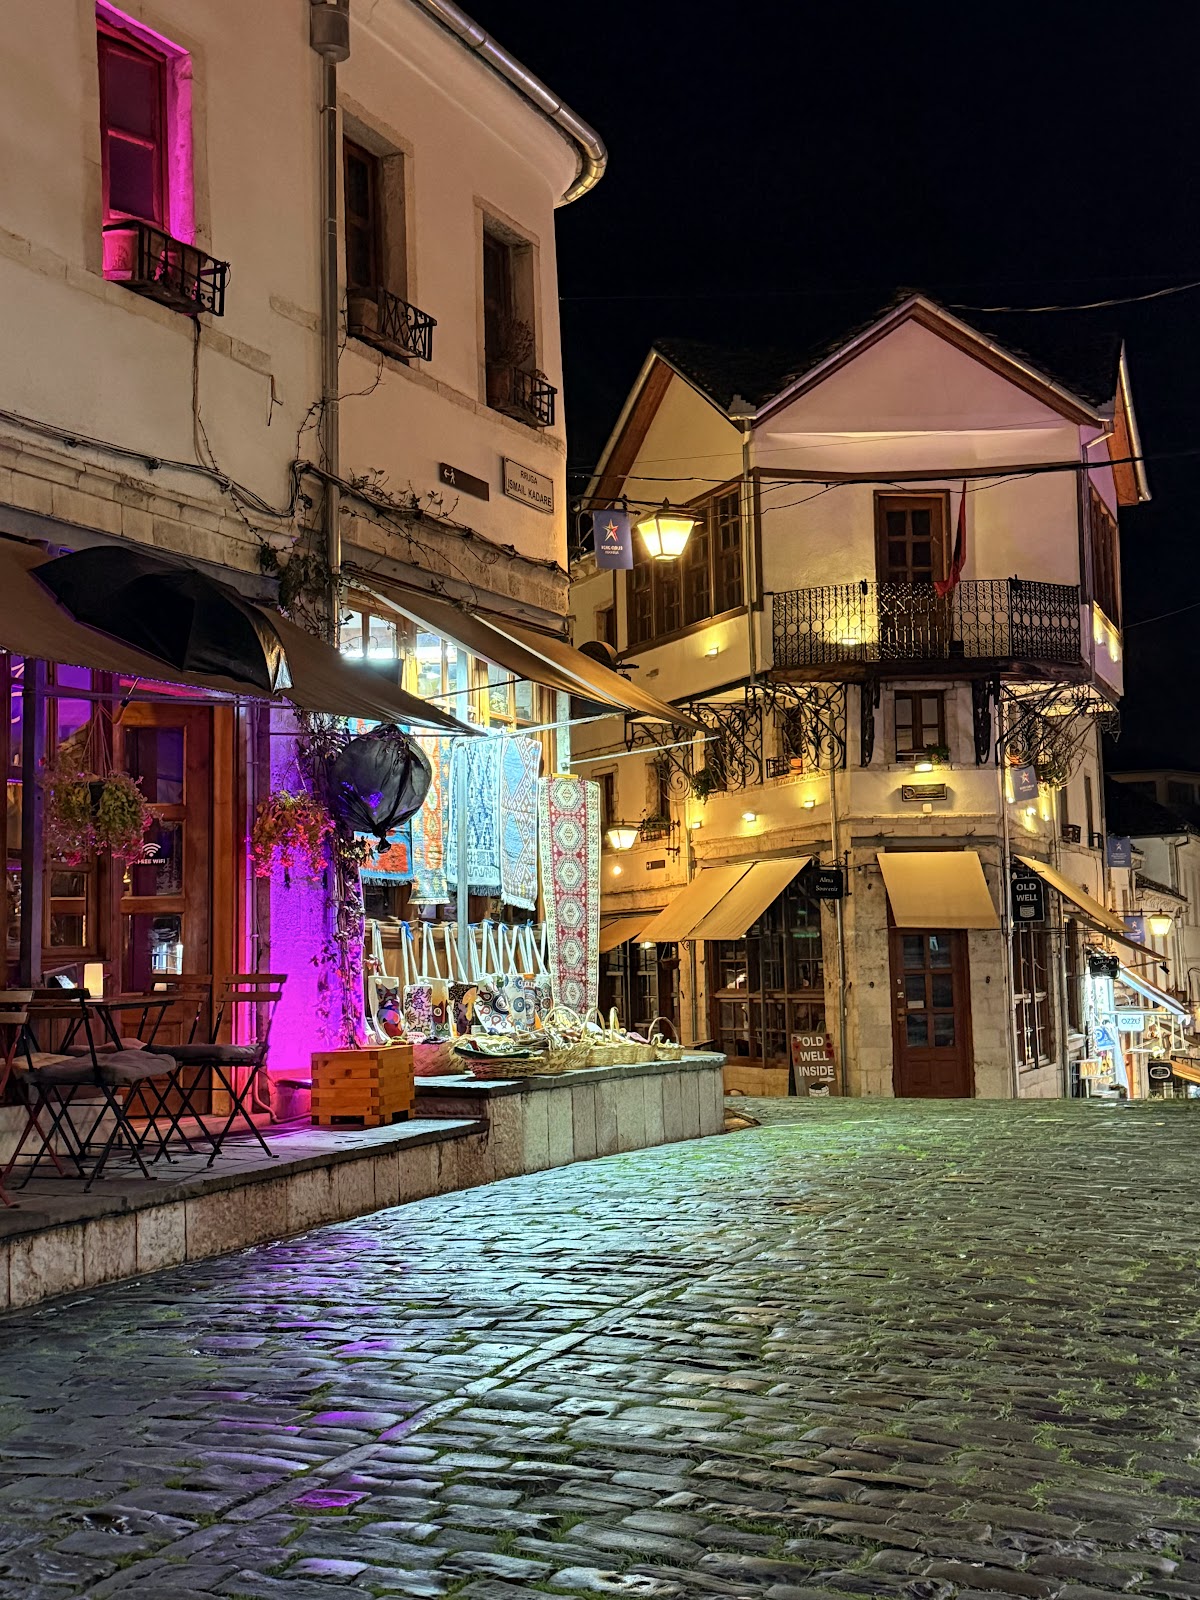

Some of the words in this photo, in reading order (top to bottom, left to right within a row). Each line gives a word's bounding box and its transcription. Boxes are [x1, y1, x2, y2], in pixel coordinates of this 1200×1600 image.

[520, 470, 538, 485] RRUGA
[507, 478, 527, 496] ISMAIL
[527, 487, 552, 507] KADARE
[815, 884, 839, 892] Souvenir
[1016, 882, 1037, 891] OLD
[1016, 893, 1038, 902] WELL
[802, 1036, 824, 1047] OLD
[800, 1050, 830, 1062] WELL
[798, 1065, 835, 1077] INSIDE
